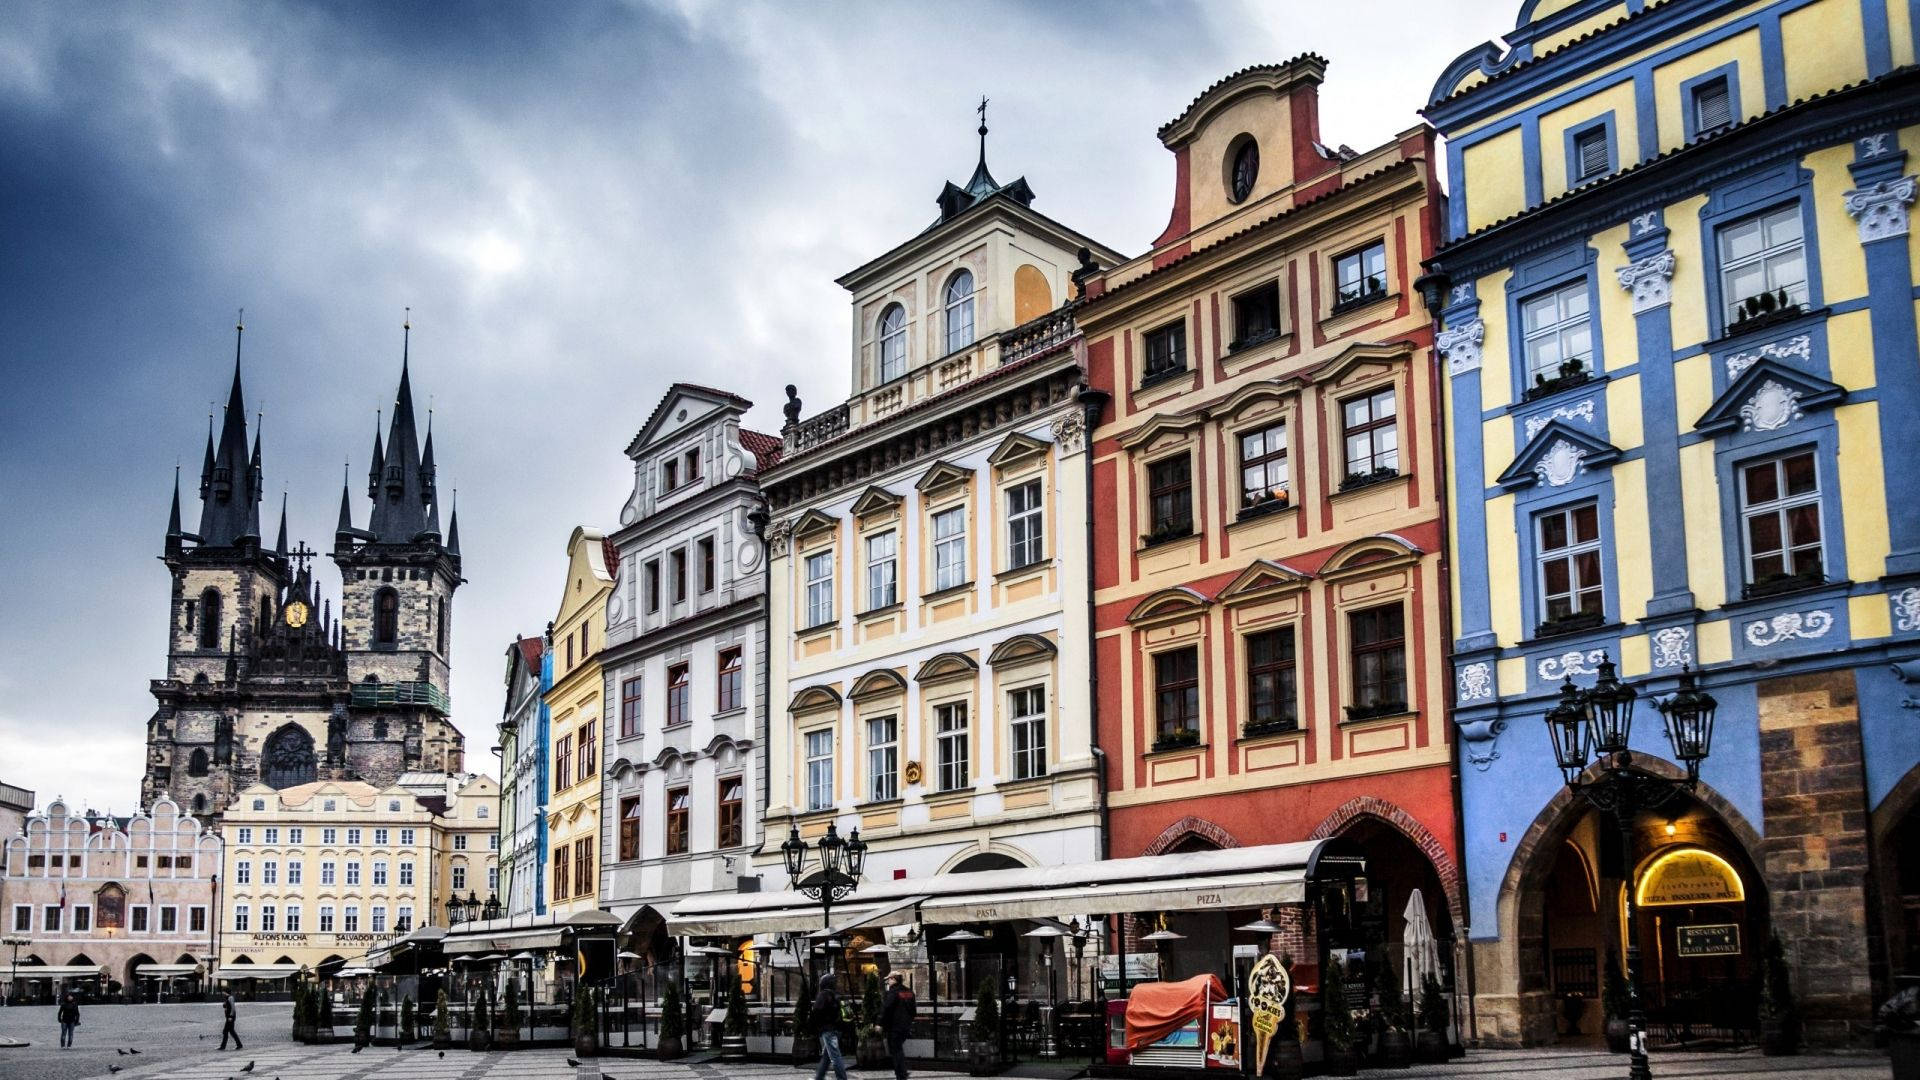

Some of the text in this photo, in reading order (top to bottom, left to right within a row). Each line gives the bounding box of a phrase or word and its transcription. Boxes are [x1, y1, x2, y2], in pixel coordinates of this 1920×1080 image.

[1196, 894, 1222, 905] PIZZA
[976, 908, 998, 919] PASTA
[253, 933, 307, 941] ALFONS MUCHA
[335, 933, 374, 941] SALVADOR
